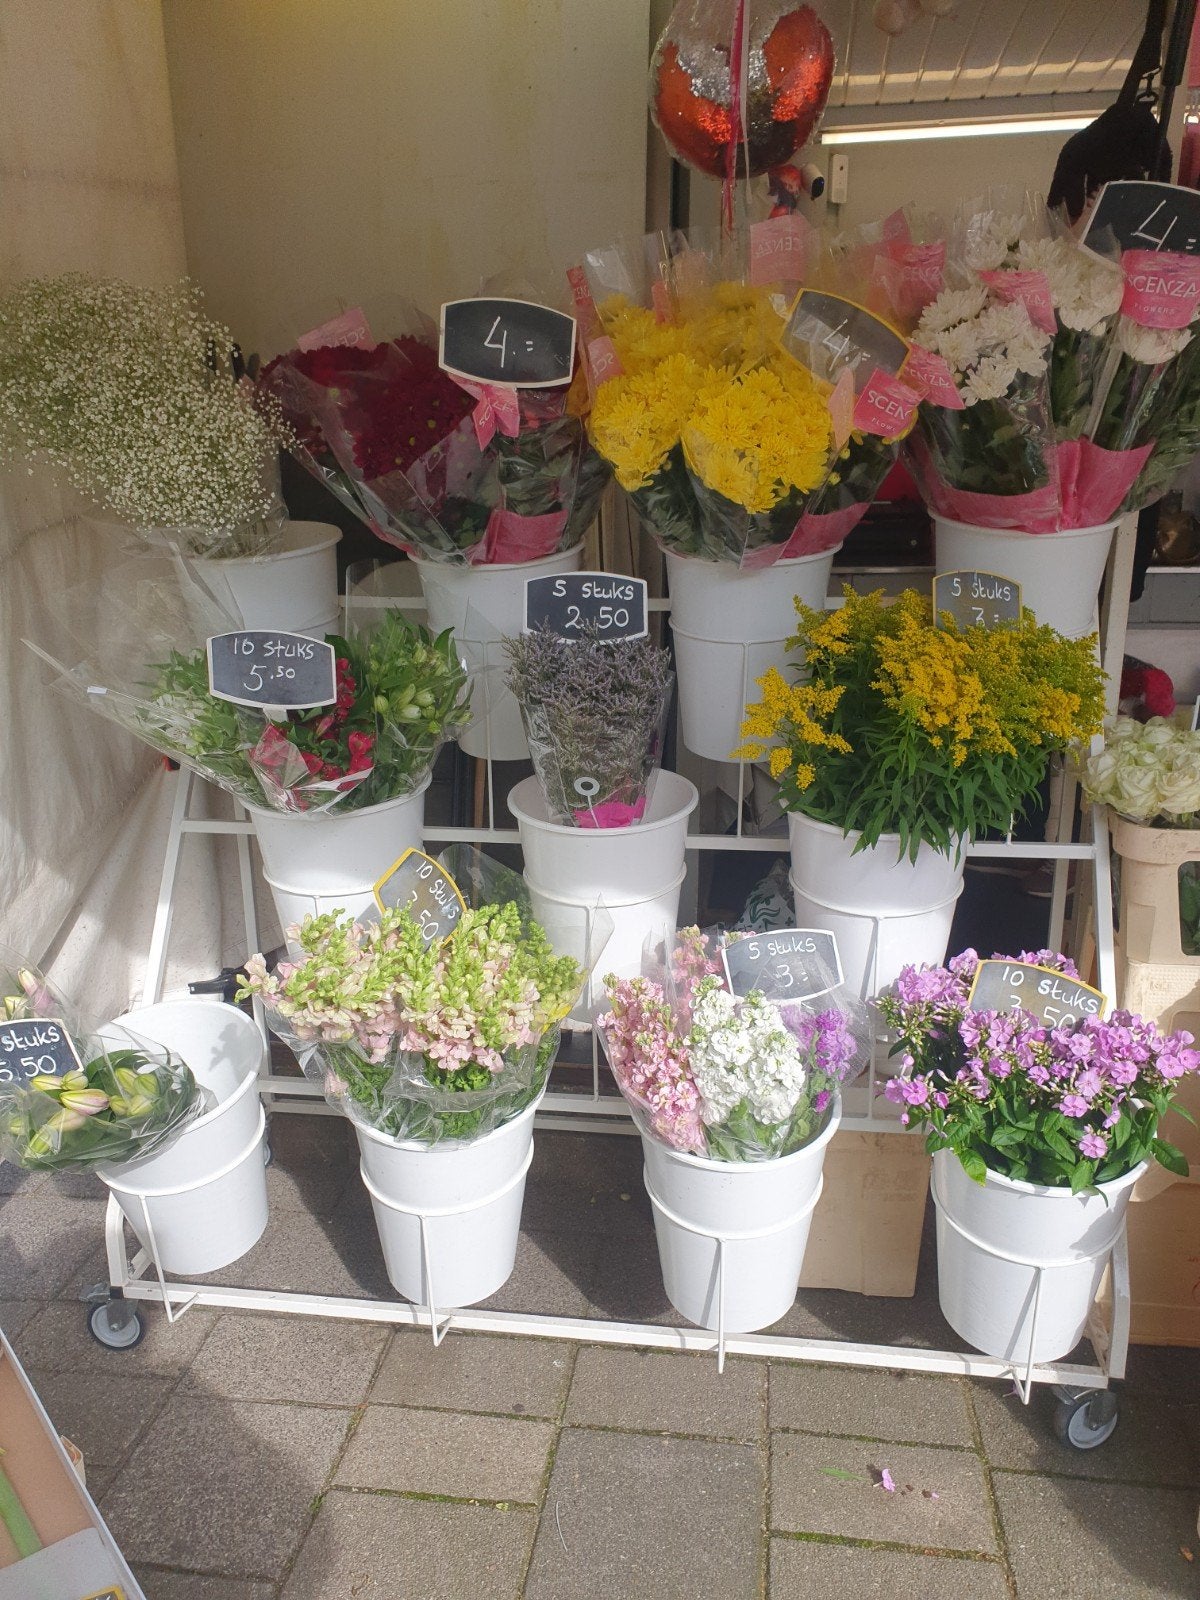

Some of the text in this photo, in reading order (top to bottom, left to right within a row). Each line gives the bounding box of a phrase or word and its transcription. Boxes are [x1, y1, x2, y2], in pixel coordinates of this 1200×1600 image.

[951, 577, 962, 597] 5
[233, 637, 255, 656] 10
[415, 860, 433, 880] 10
[748, 941, 761, 960] 5
[1002, 965, 1024, 987] 10
